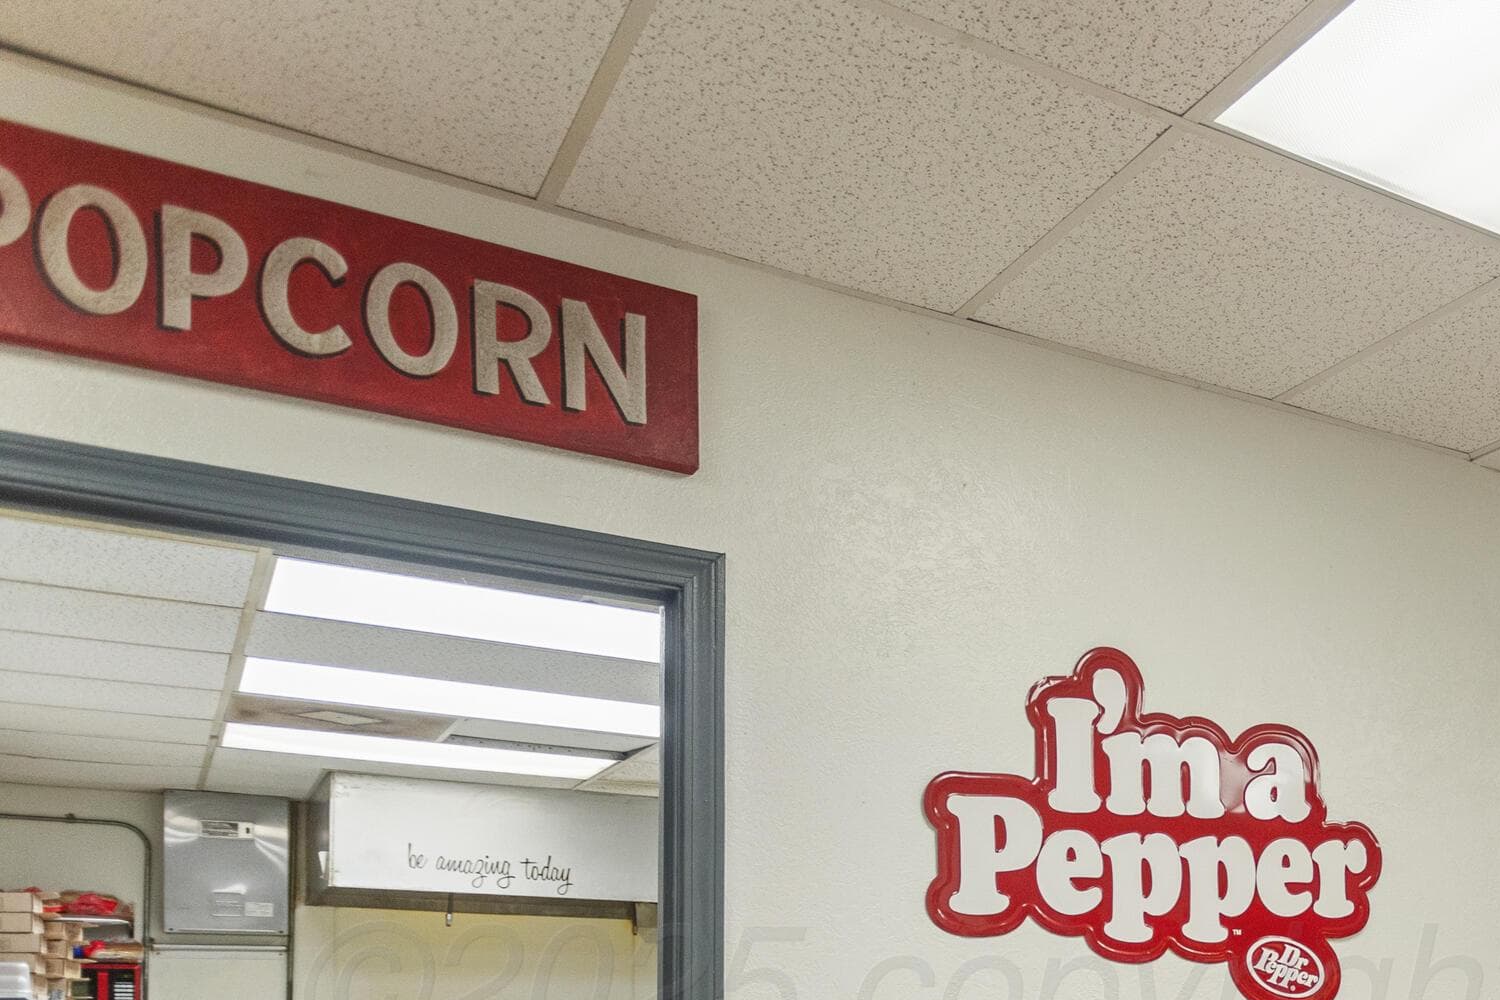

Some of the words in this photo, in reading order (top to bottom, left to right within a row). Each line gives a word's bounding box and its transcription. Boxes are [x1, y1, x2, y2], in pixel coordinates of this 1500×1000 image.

[1046, 668, 1226, 818] I'm
[1243, 743, 1313, 823] a
[408, 843, 426, 869] be
[435, 855, 516, 889] amazing
[520, 855, 574, 895] today
[947, 794, 1367, 943] Pepper
[1253, 947, 1319, 988] Pepper
[1278, 944, 1309, 969] Dr
